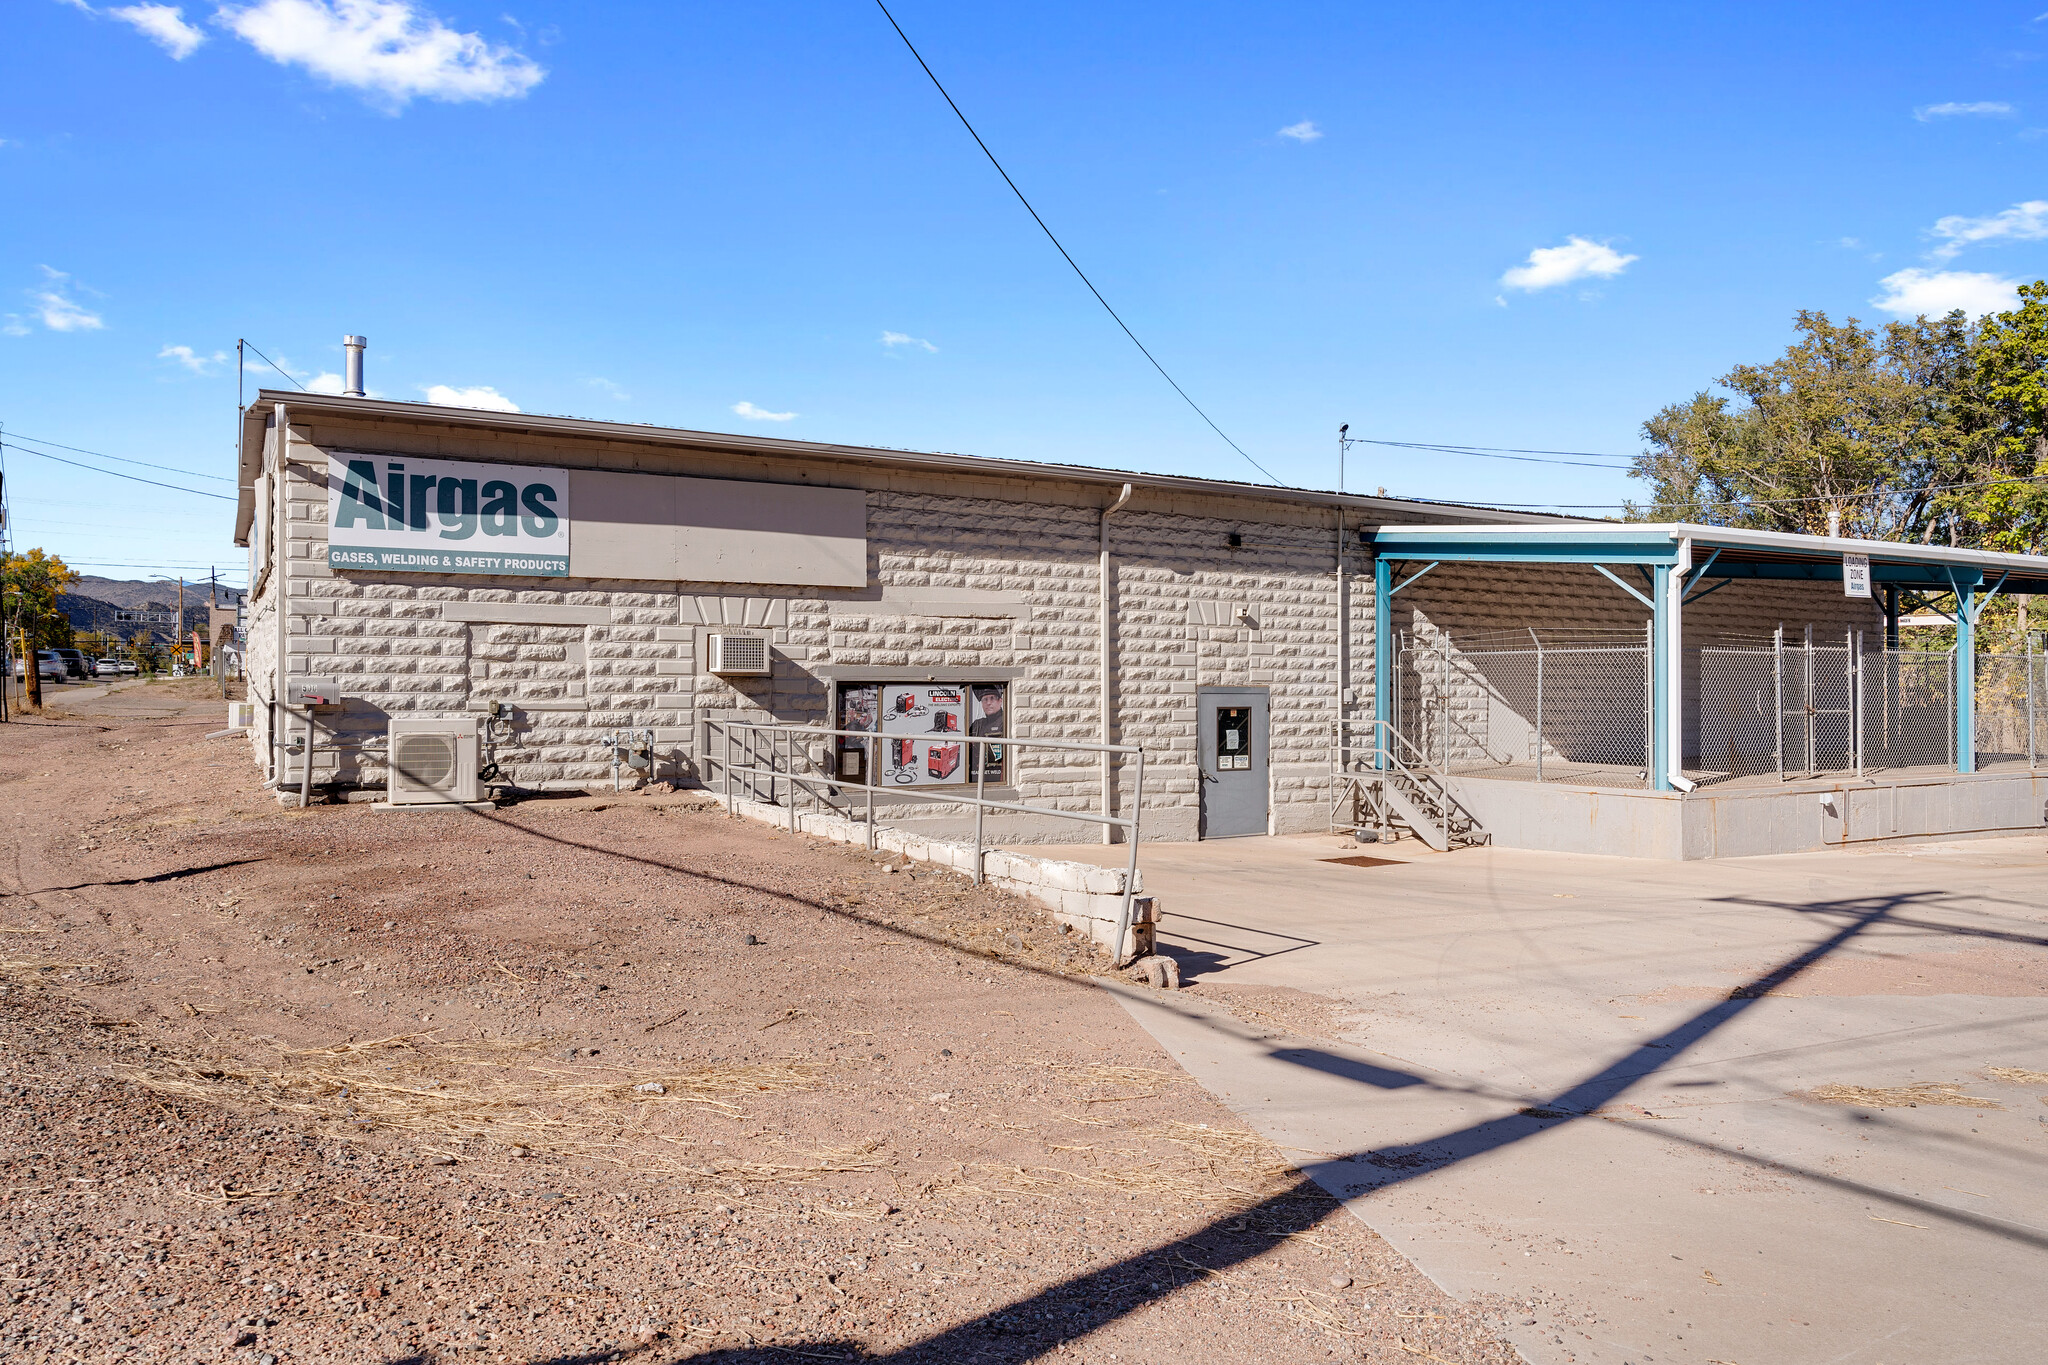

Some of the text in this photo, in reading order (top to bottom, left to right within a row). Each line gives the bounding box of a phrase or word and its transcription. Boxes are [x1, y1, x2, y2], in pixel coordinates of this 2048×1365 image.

[334, 460, 559, 540] Airgas
[331, 551, 566, 571] GASES, WELDING & SAFETY PRODUCTS
[1845, 556, 1867, 567] LOADING
[1850, 569, 1863, 579] ZONE
